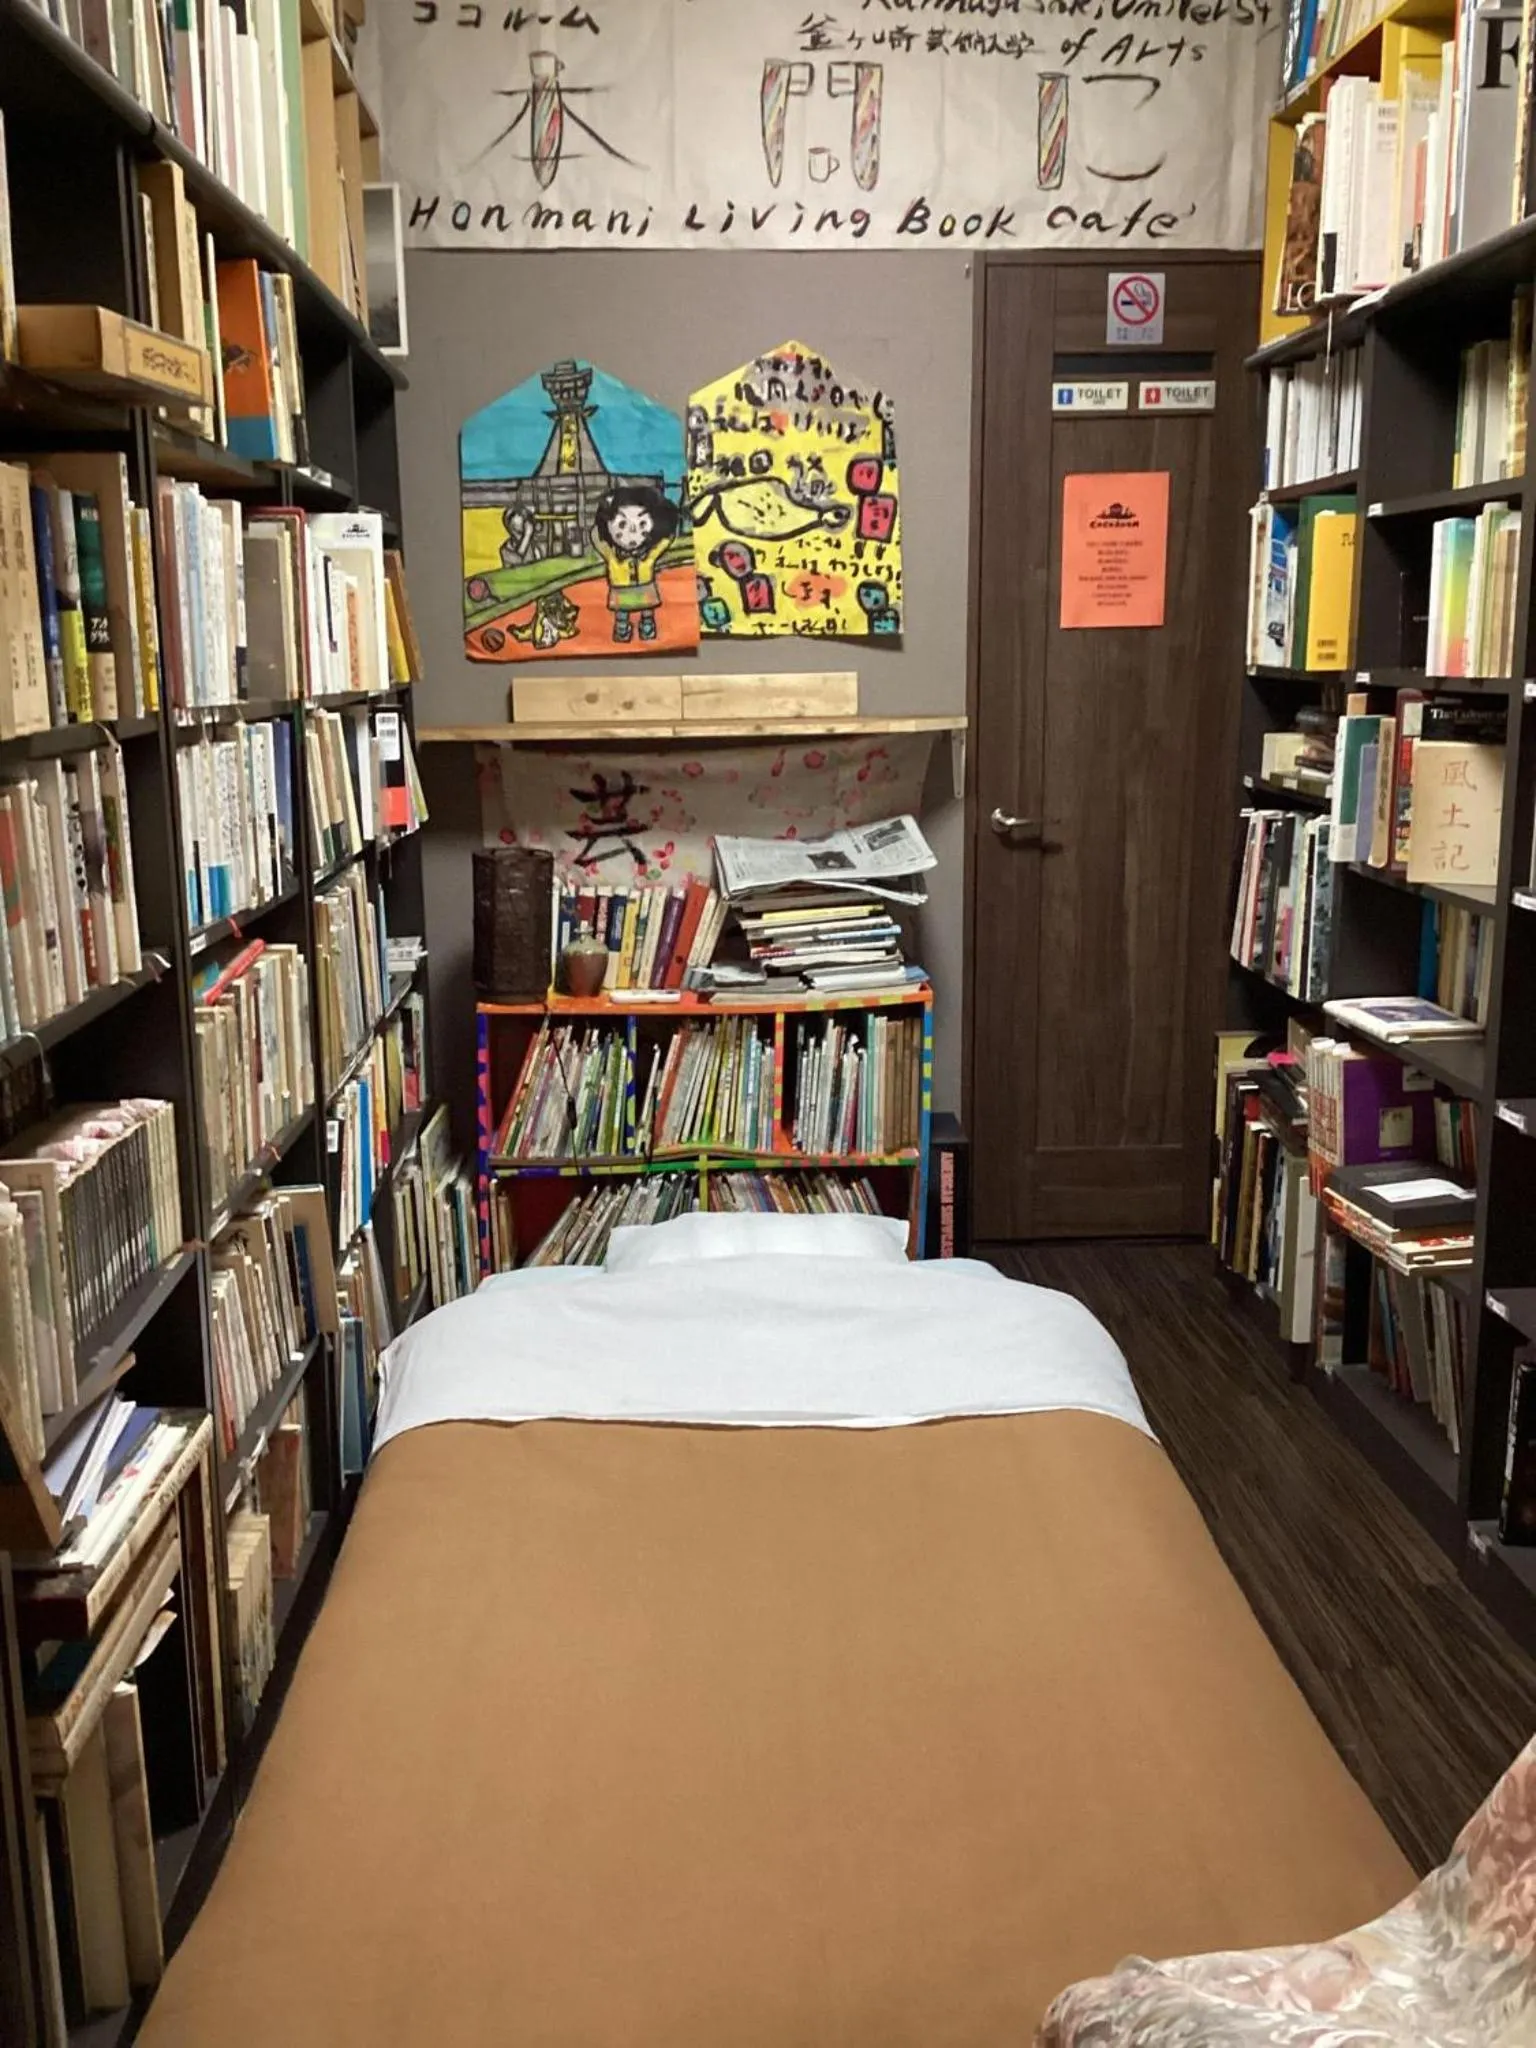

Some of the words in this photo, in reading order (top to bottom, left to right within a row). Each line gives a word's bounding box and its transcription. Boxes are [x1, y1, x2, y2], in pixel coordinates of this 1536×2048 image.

[1061, 27, 1098, 65] of
[1100, 33, 1206, 64] Arts
[408, 197, 654, 237] Honmani
[896, 197, 1017, 238] Book
[1077, 387, 1123, 400] TOILET
[1164, 386, 1210, 399] TOILET
